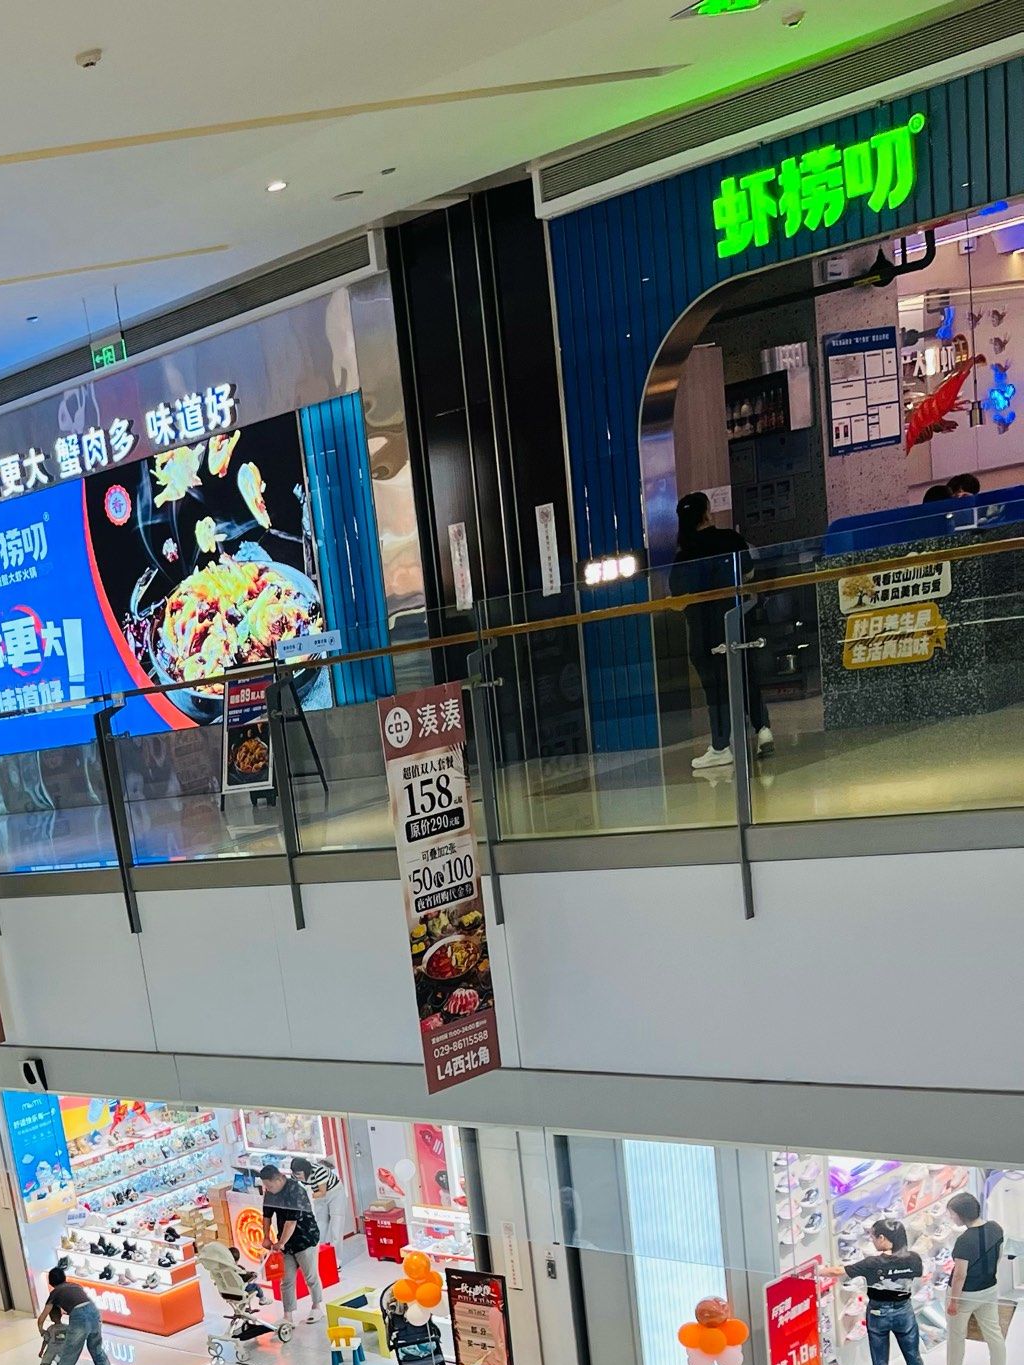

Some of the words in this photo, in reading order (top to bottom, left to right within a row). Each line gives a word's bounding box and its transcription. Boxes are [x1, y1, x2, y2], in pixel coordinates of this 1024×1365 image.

[55, 418, 136, 479] 蟹肉多
[145, 383, 236, 446] 味道好
[402, 755, 455, 781] 超值双人套餐
[433, 1029, 489, 1057] 029-86115588
[436, 1044, 491, 1082] L4西北角
